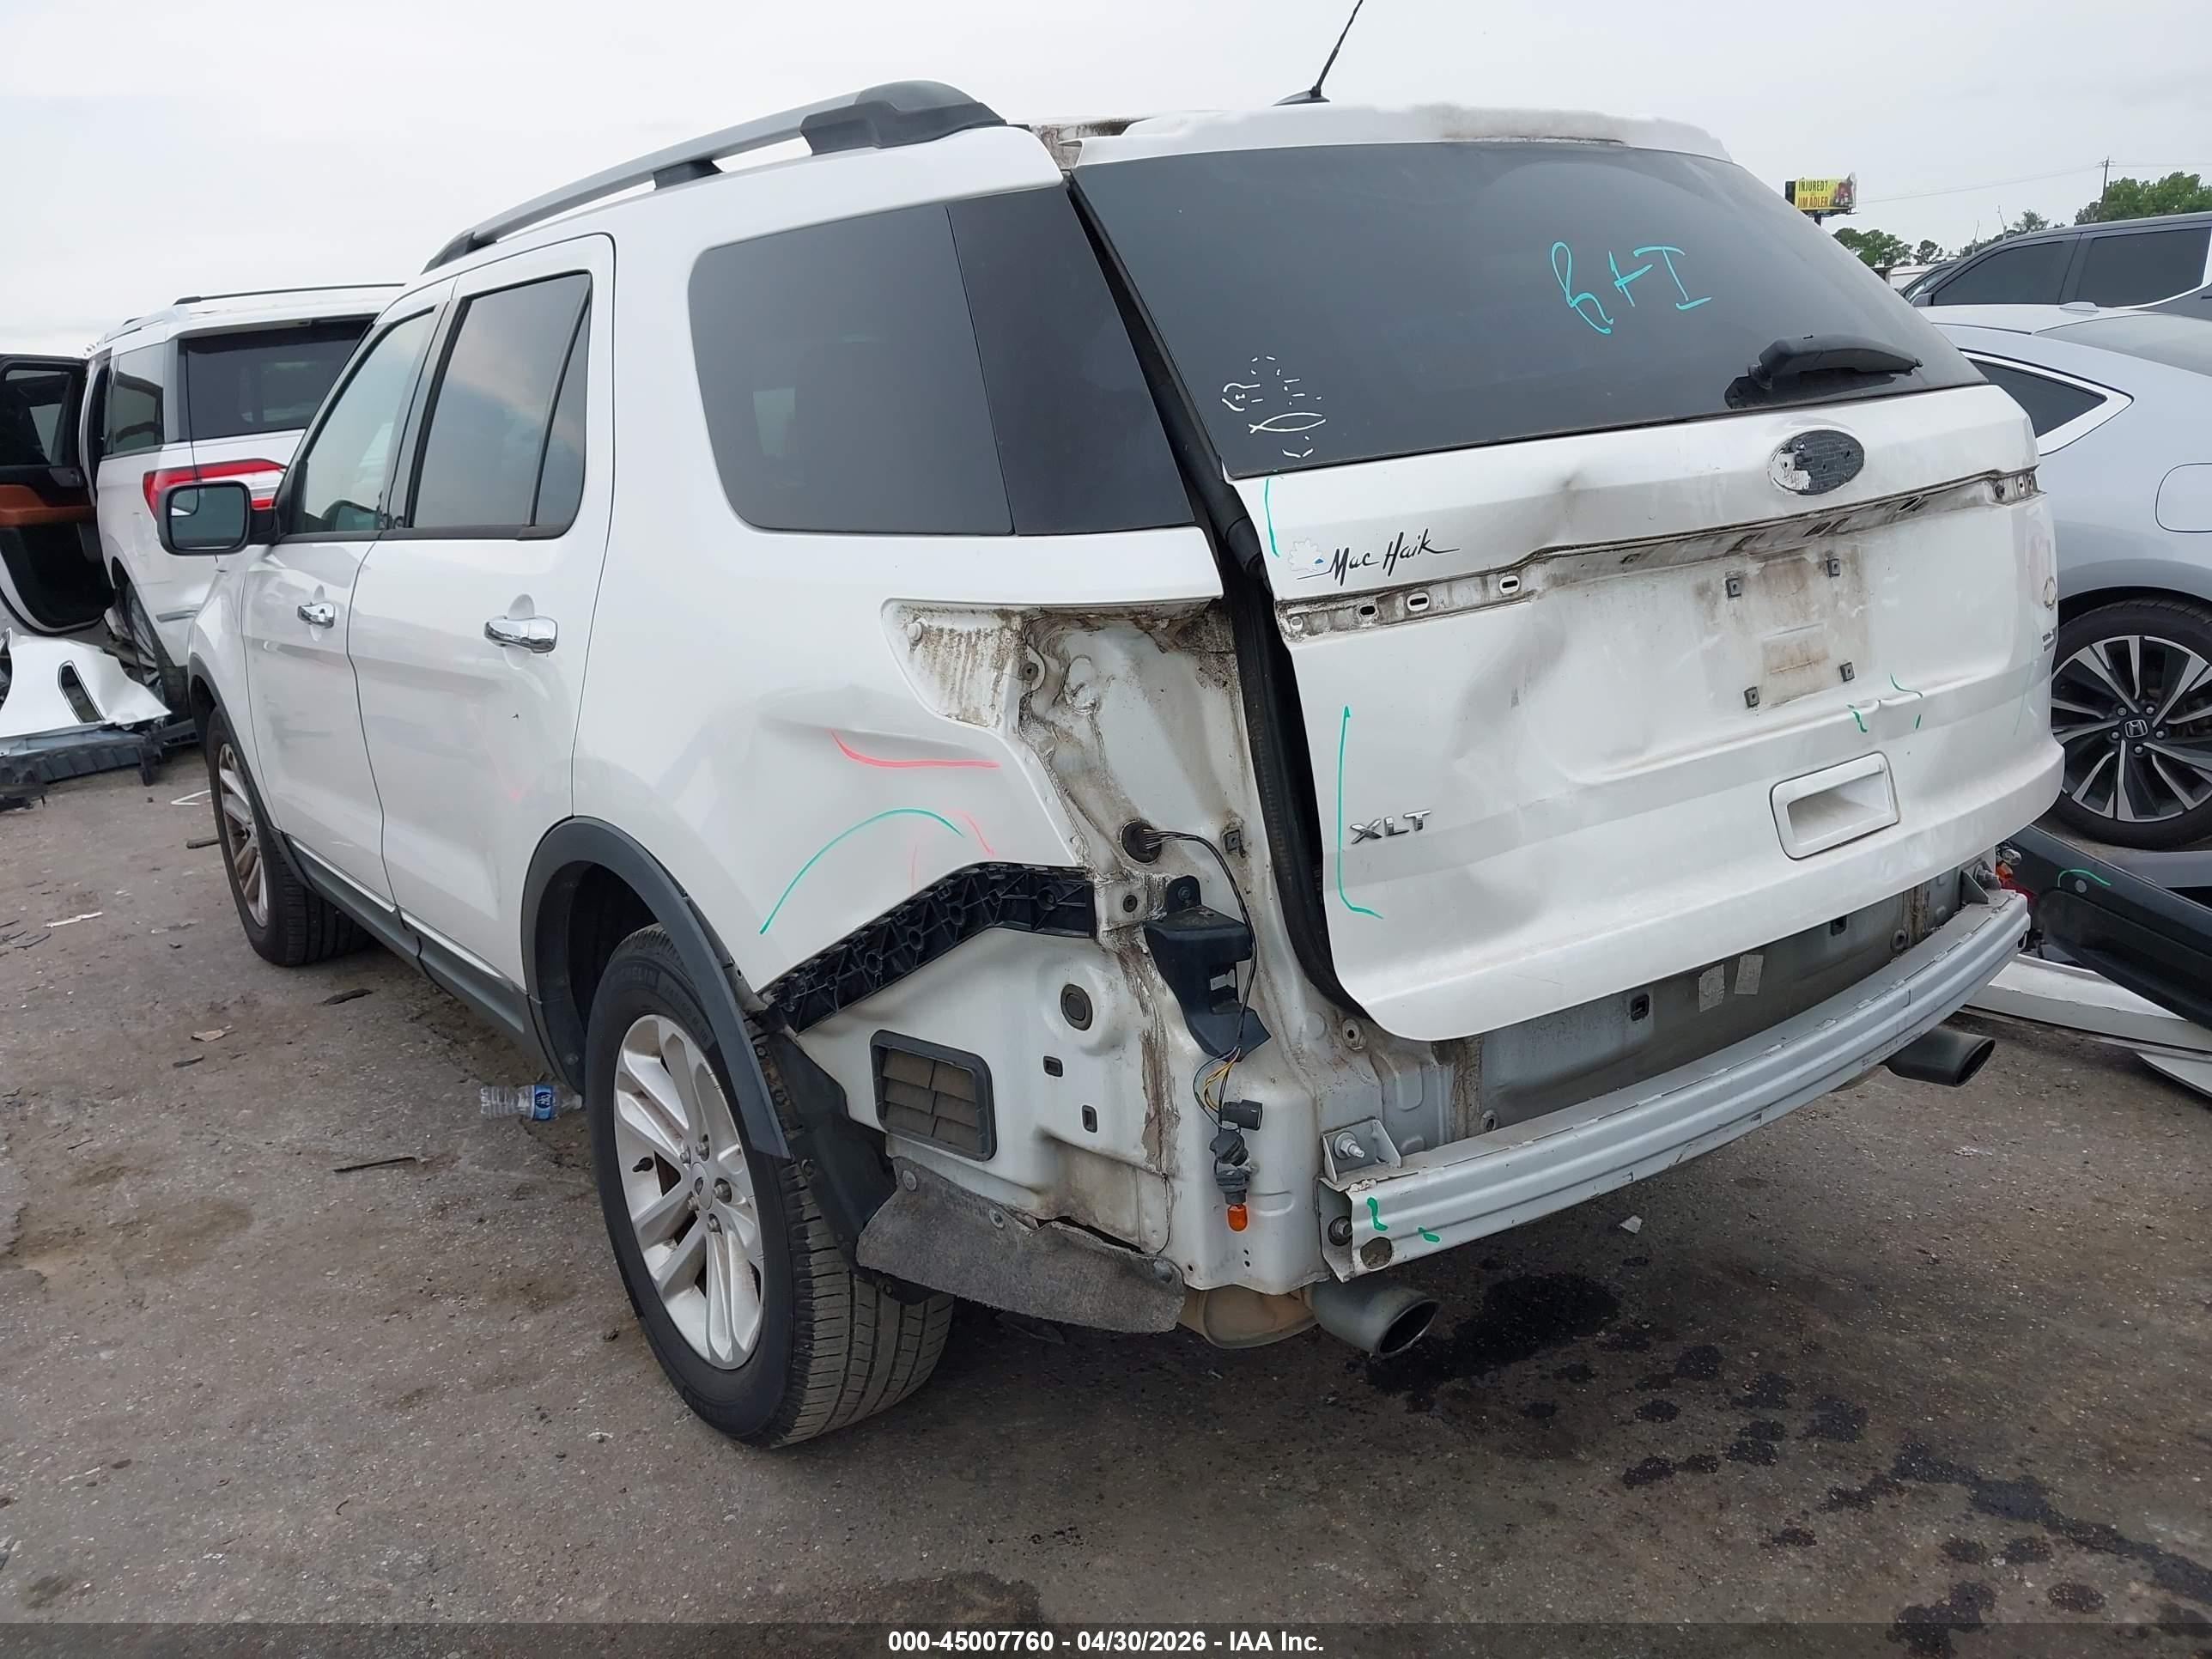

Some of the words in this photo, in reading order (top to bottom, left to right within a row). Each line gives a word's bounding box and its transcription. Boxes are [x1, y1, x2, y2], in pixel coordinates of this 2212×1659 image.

[1798, 180, 1828, 192] INJURED?
[1809, 196, 1828, 208] ADLER
[1297, 547, 1379, 586] Mac
[1382, 528, 1460, 577] Haik
[1349, 809, 1431, 845] XLT
